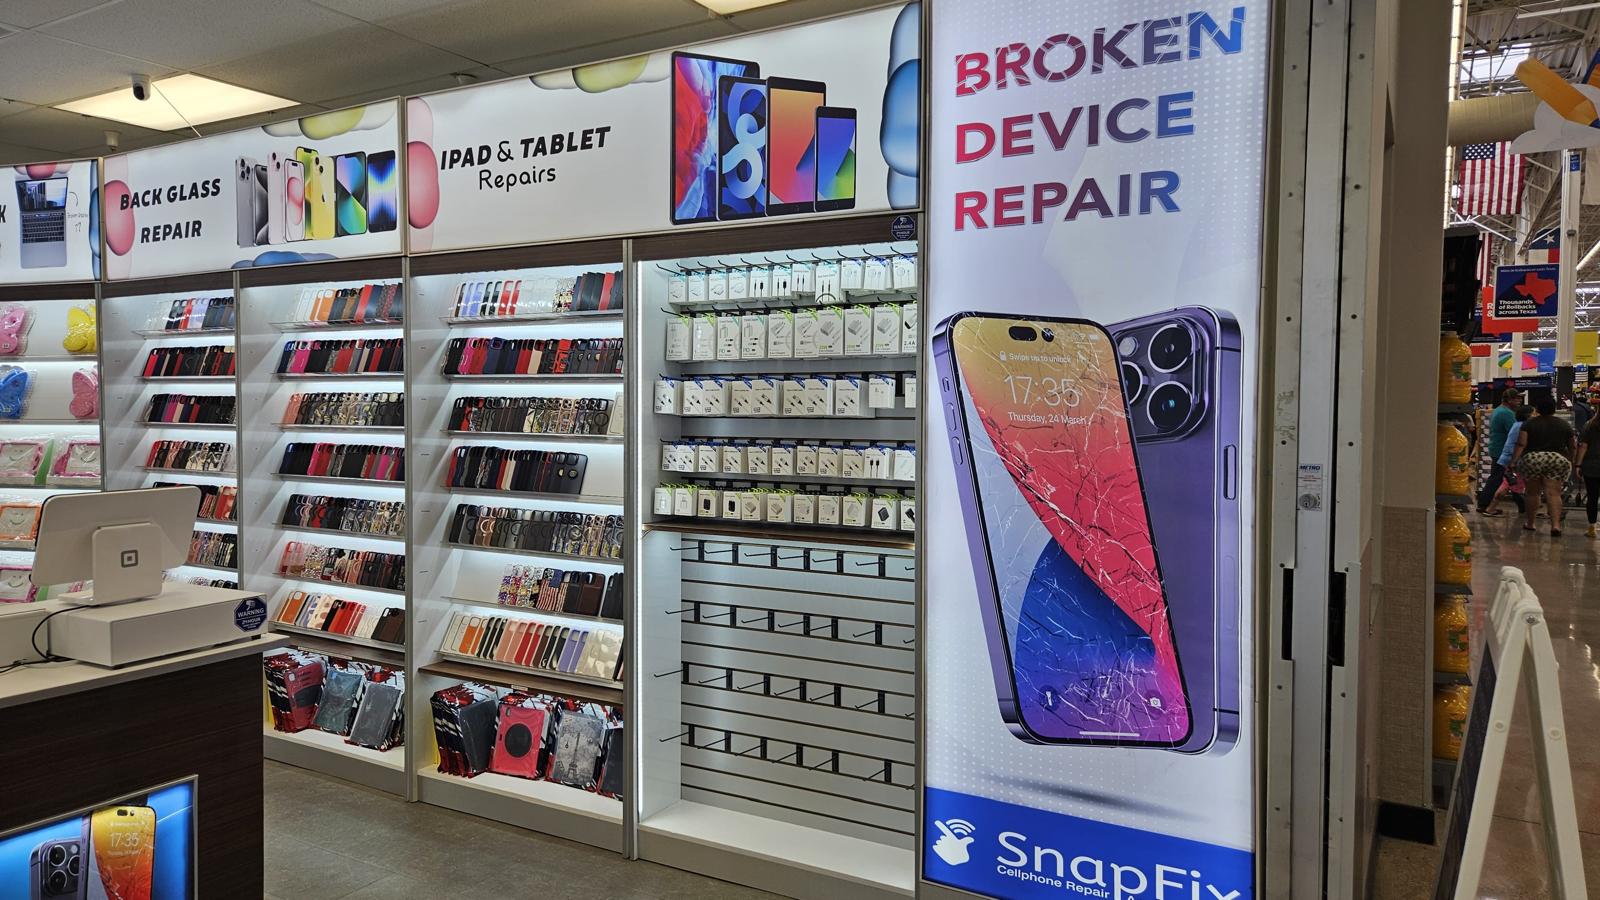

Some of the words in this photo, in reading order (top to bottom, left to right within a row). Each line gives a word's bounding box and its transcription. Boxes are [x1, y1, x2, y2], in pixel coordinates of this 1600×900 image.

[955, 6, 1247, 97] BROKEN
[955, 90, 1195, 164] DEVICE
[439, 142, 492, 171] IPAD
[496, 140, 514, 162] &
[520, 125, 612, 159] TABLET
[119, 188, 163, 211] BACK
[166, 178, 222, 203] GLASS
[478, 165, 557, 192] Repairs
[954, 169, 1182, 232] REPAIR
[140, 220, 202, 244] REPAIR
[1009, 353, 1030, 362] Swipe
[1049, 354, 1071, 363] unlock
[1003, 375, 1081, 408] 17:35
[1008, 411, 1047, 425] Thursday,
[1048, 414, 1059, 424] 24
[1061, 414, 1087, 425] March
[237, 608, 265, 618] WARNING
[110, 832, 140, 848] 17:35
[996, 865, 1063, 889] Cellphone
[1066, 880, 1111, 900] Repair
